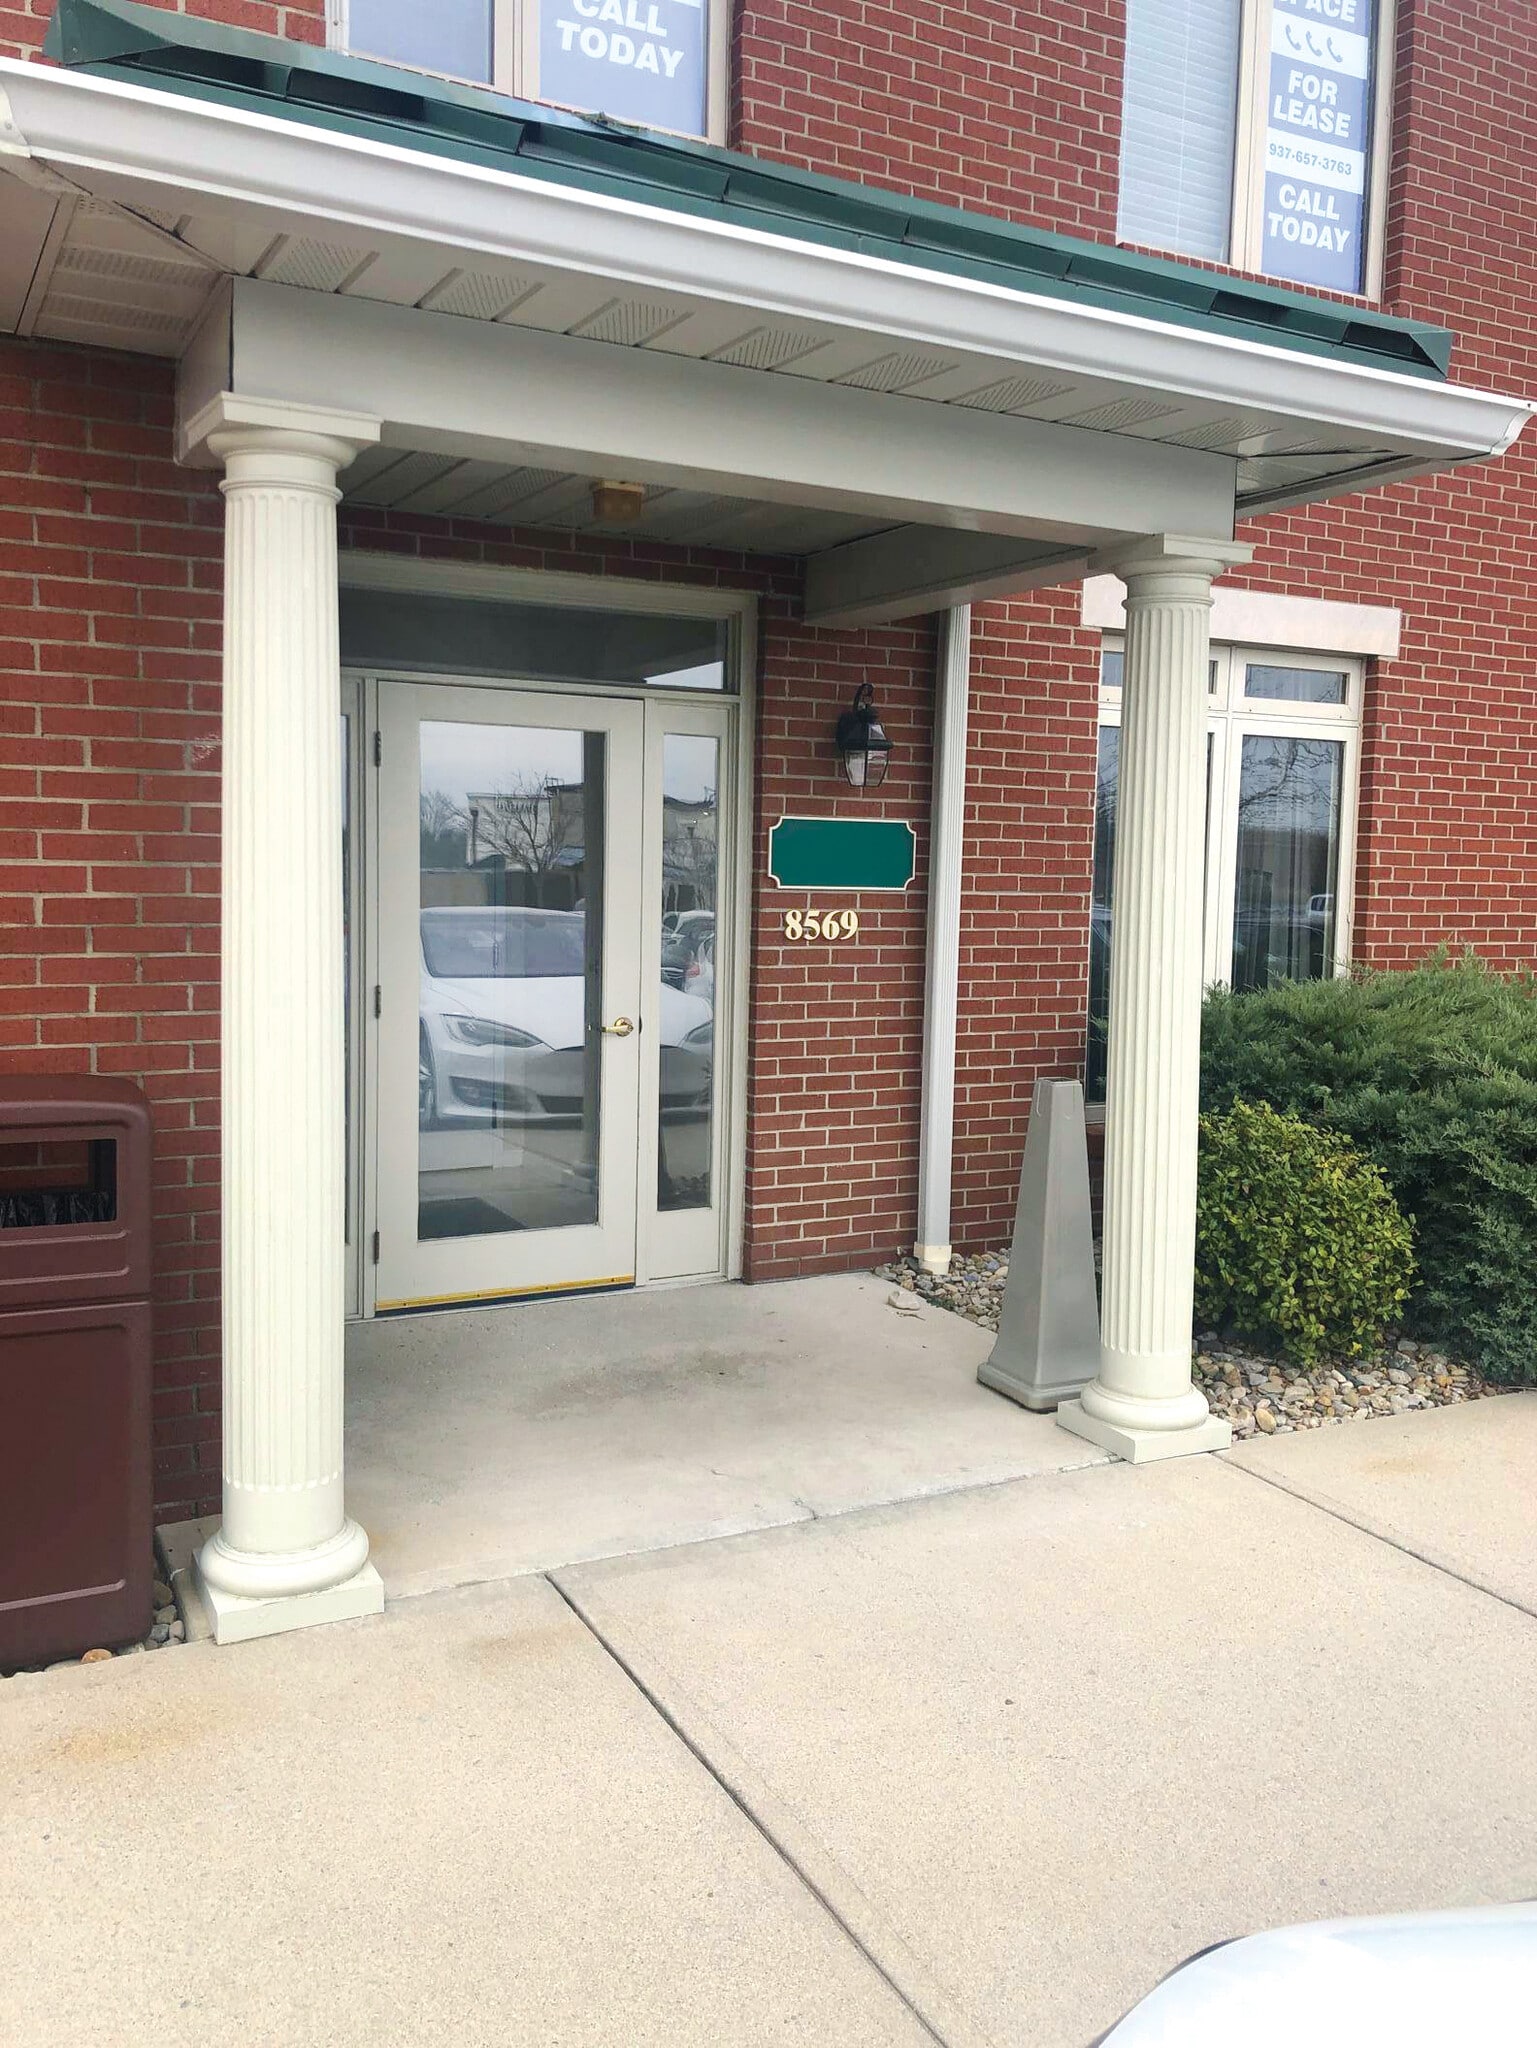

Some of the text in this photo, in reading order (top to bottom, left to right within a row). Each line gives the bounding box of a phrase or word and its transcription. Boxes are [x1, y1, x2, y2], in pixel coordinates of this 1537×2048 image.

[573, 0, 667, 37] CALL
[1279, 0, 1356, 23] ACE
[555, 19, 685, 78] TODAY
[1288, 70, 1338, 105] FOR
[1274, 95, 1351, 137] LEASE
[1279, 184, 1340, 220] CALL
[1268, 212, 1350, 252] TODAY
[784, 909, 859, 941] 8569
